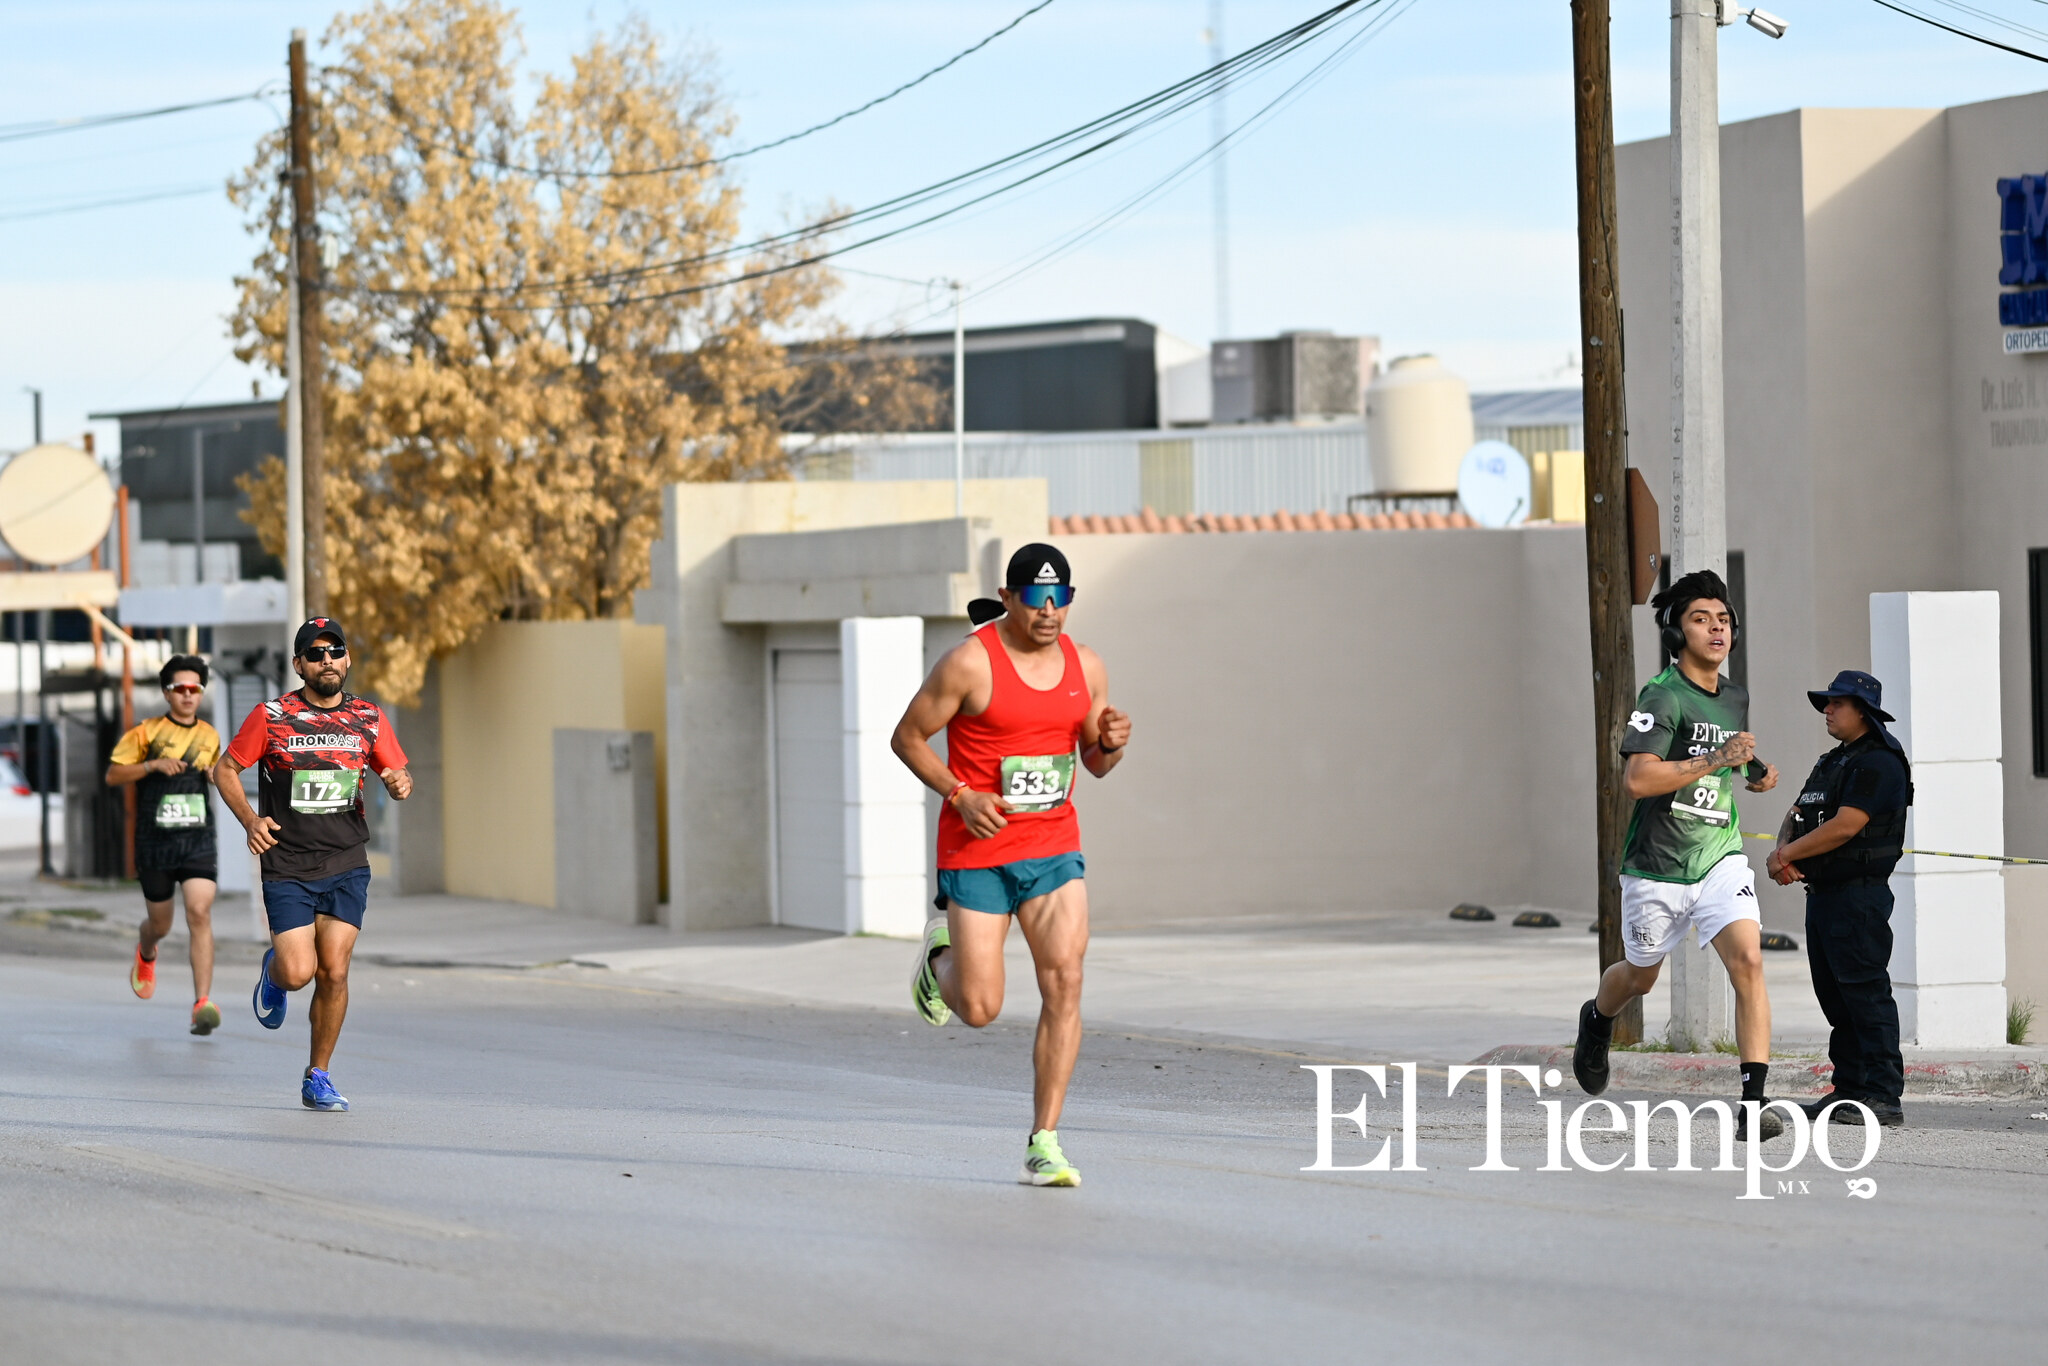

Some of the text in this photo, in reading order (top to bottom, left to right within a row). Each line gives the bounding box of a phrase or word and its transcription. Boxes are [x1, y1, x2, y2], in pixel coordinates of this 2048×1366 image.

[290, 733, 361, 748] IRONCAST
[1691, 722, 1709, 742] El
[302, 782, 341, 800] 172
[1010, 770, 1060, 795] 533
[1694, 787, 1718, 809] 99
[162, 803, 190, 817] 331
